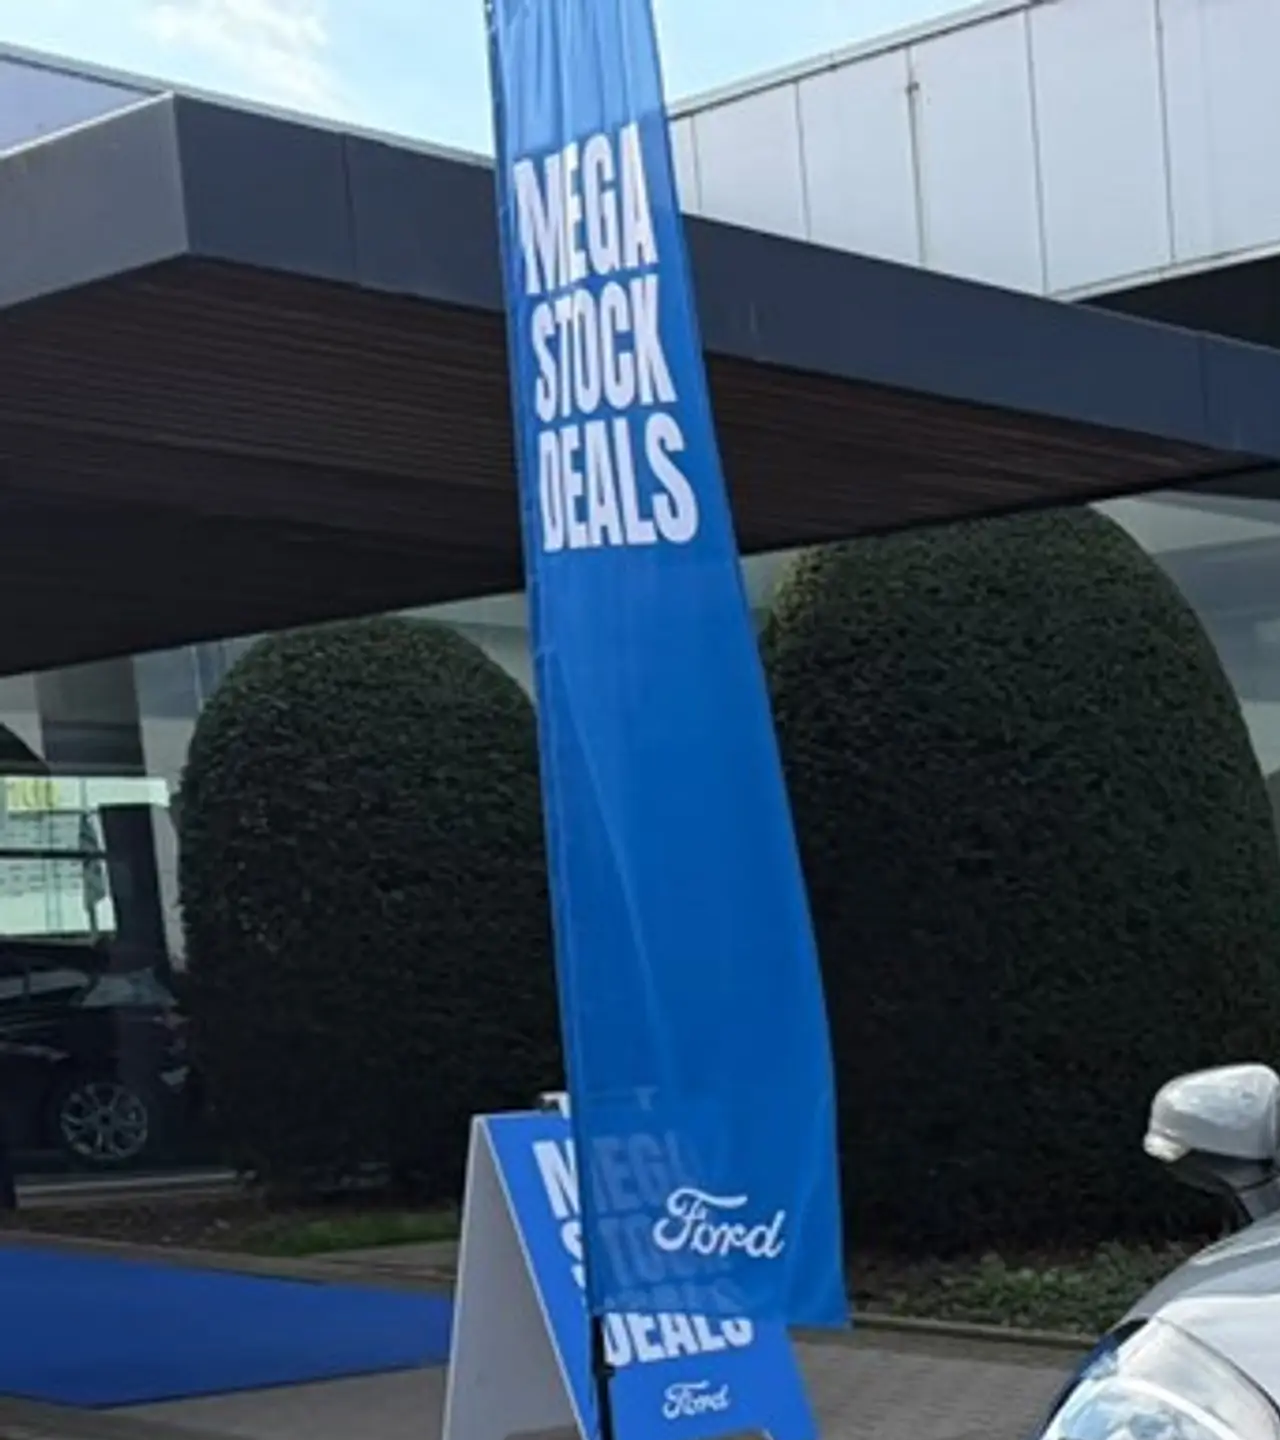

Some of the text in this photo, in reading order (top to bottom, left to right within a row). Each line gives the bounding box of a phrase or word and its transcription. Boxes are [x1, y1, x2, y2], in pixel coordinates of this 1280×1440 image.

[513, 122, 658, 295] MEGA
[531, 273, 677, 424] STOCK
[537, 413, 698, 553] DEALS
[653, 1188, 785, 1258] Ford
[663, 1381, 731, 1420] Ford
